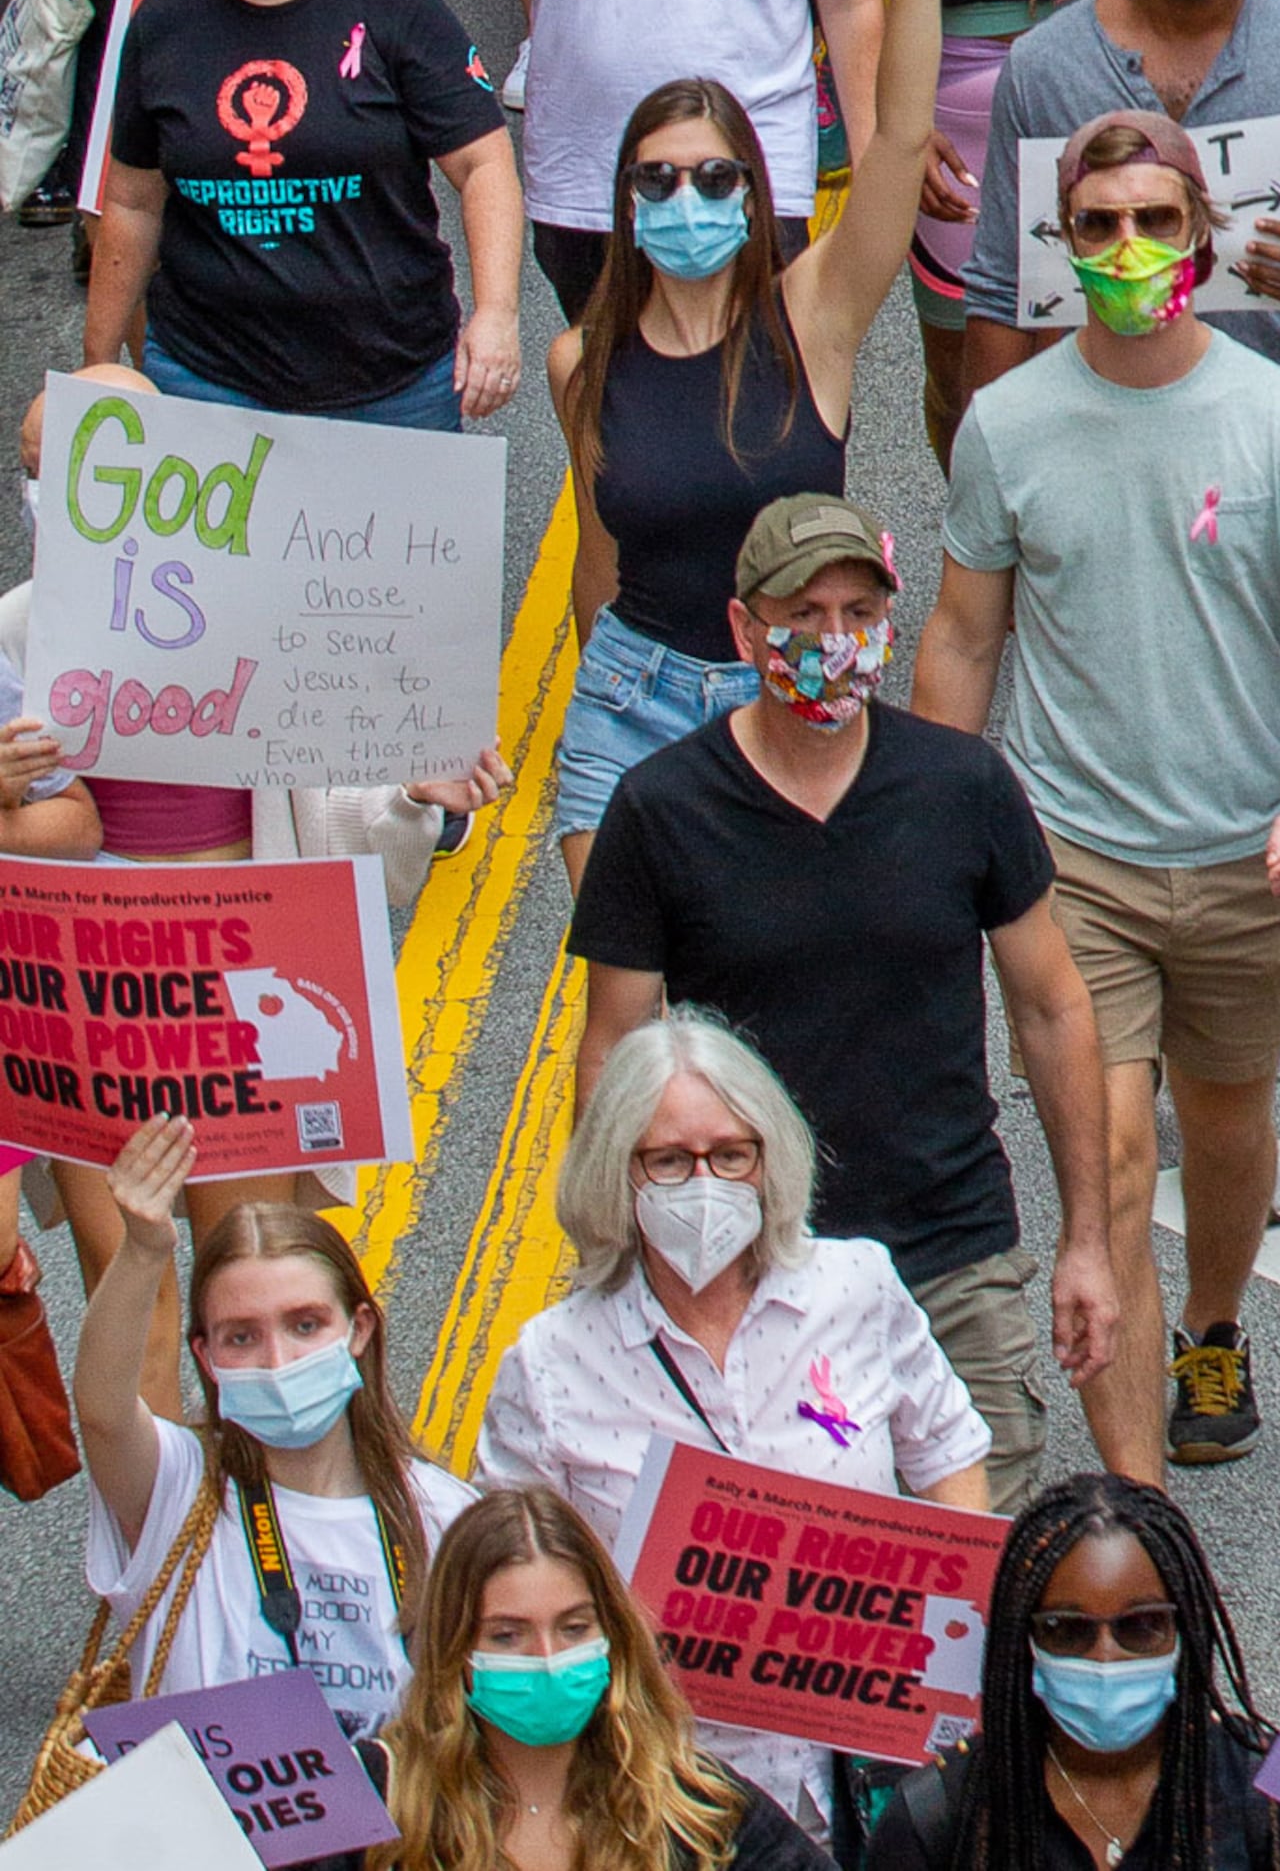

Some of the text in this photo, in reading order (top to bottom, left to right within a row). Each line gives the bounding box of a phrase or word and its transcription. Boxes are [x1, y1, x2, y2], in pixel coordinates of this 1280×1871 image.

[66, 396, 274, 556] God
[109, 537, 206, 649] is
[48, 657, 261, 770] good.
[253, 1503, 282, 1571] Nikon
